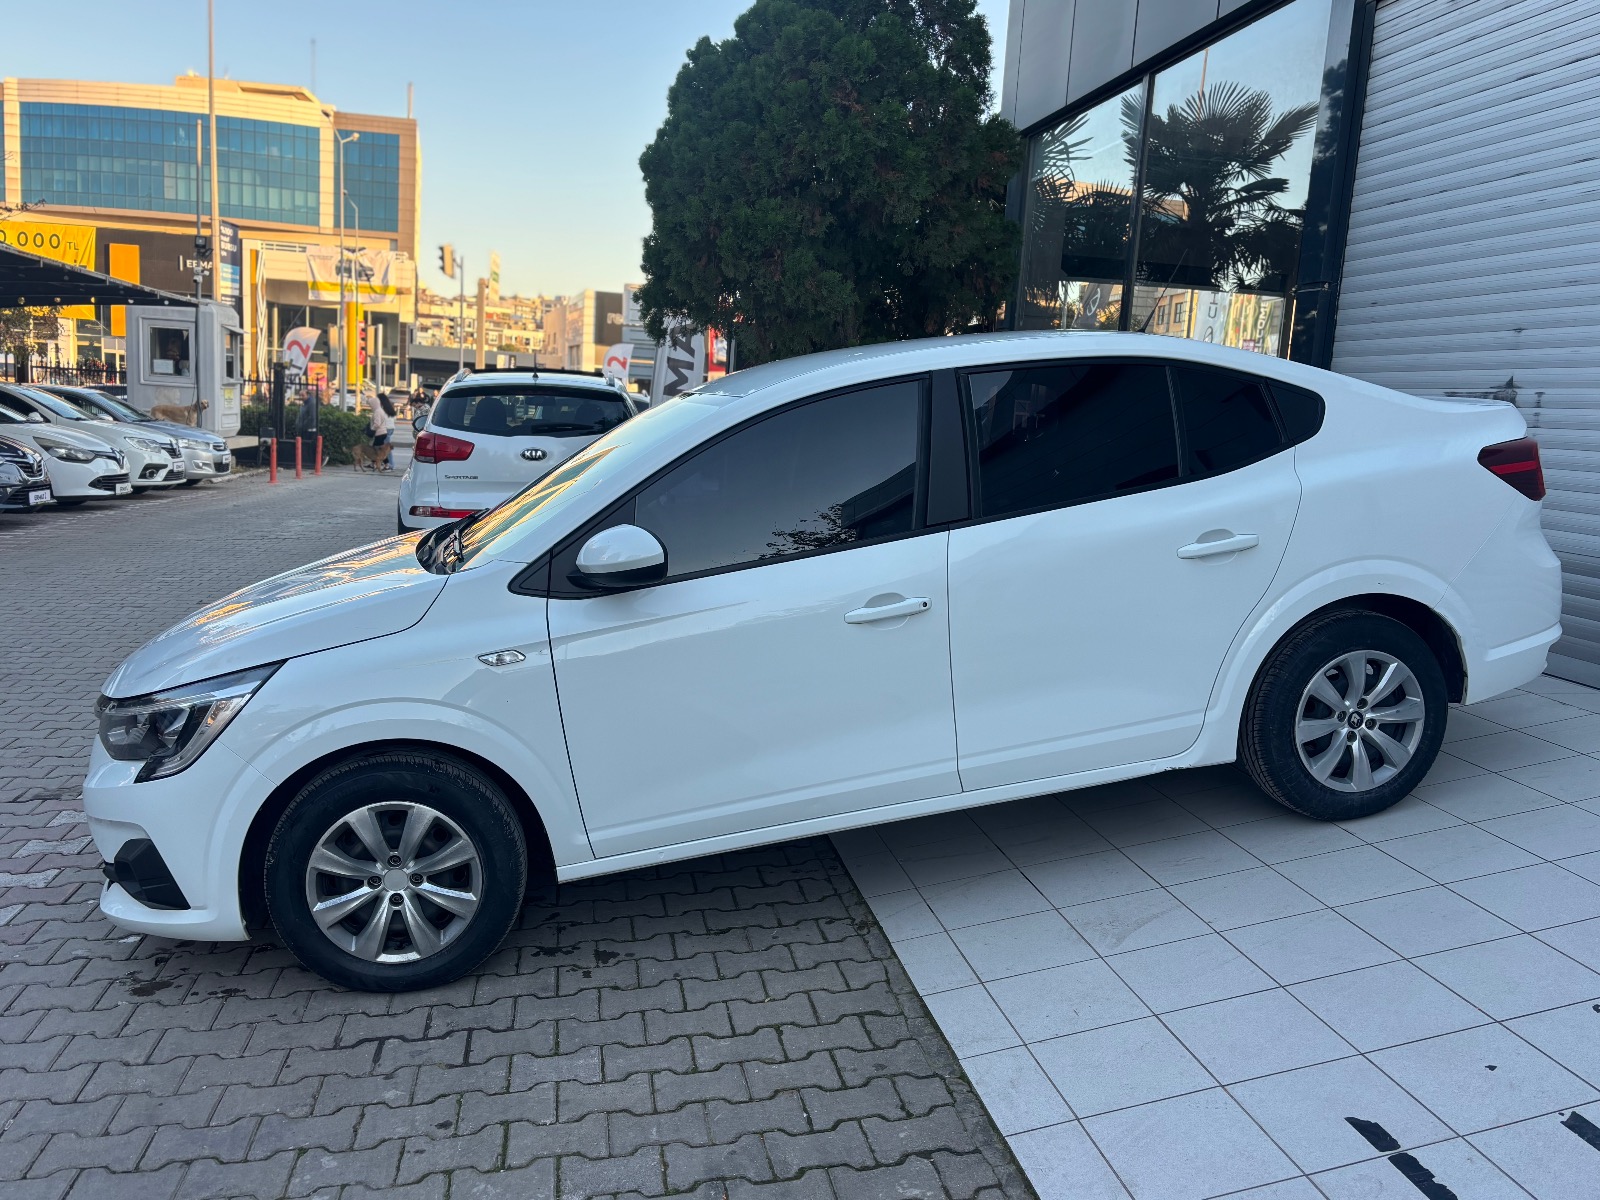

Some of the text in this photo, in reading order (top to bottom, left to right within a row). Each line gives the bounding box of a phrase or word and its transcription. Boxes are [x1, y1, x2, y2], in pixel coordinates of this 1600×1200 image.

[66, 241, 80, 251] TL
[287, 339, 311, 359] 2
[607, 356, 628, 370] 2
[524, 450, 543, 458] KIA
